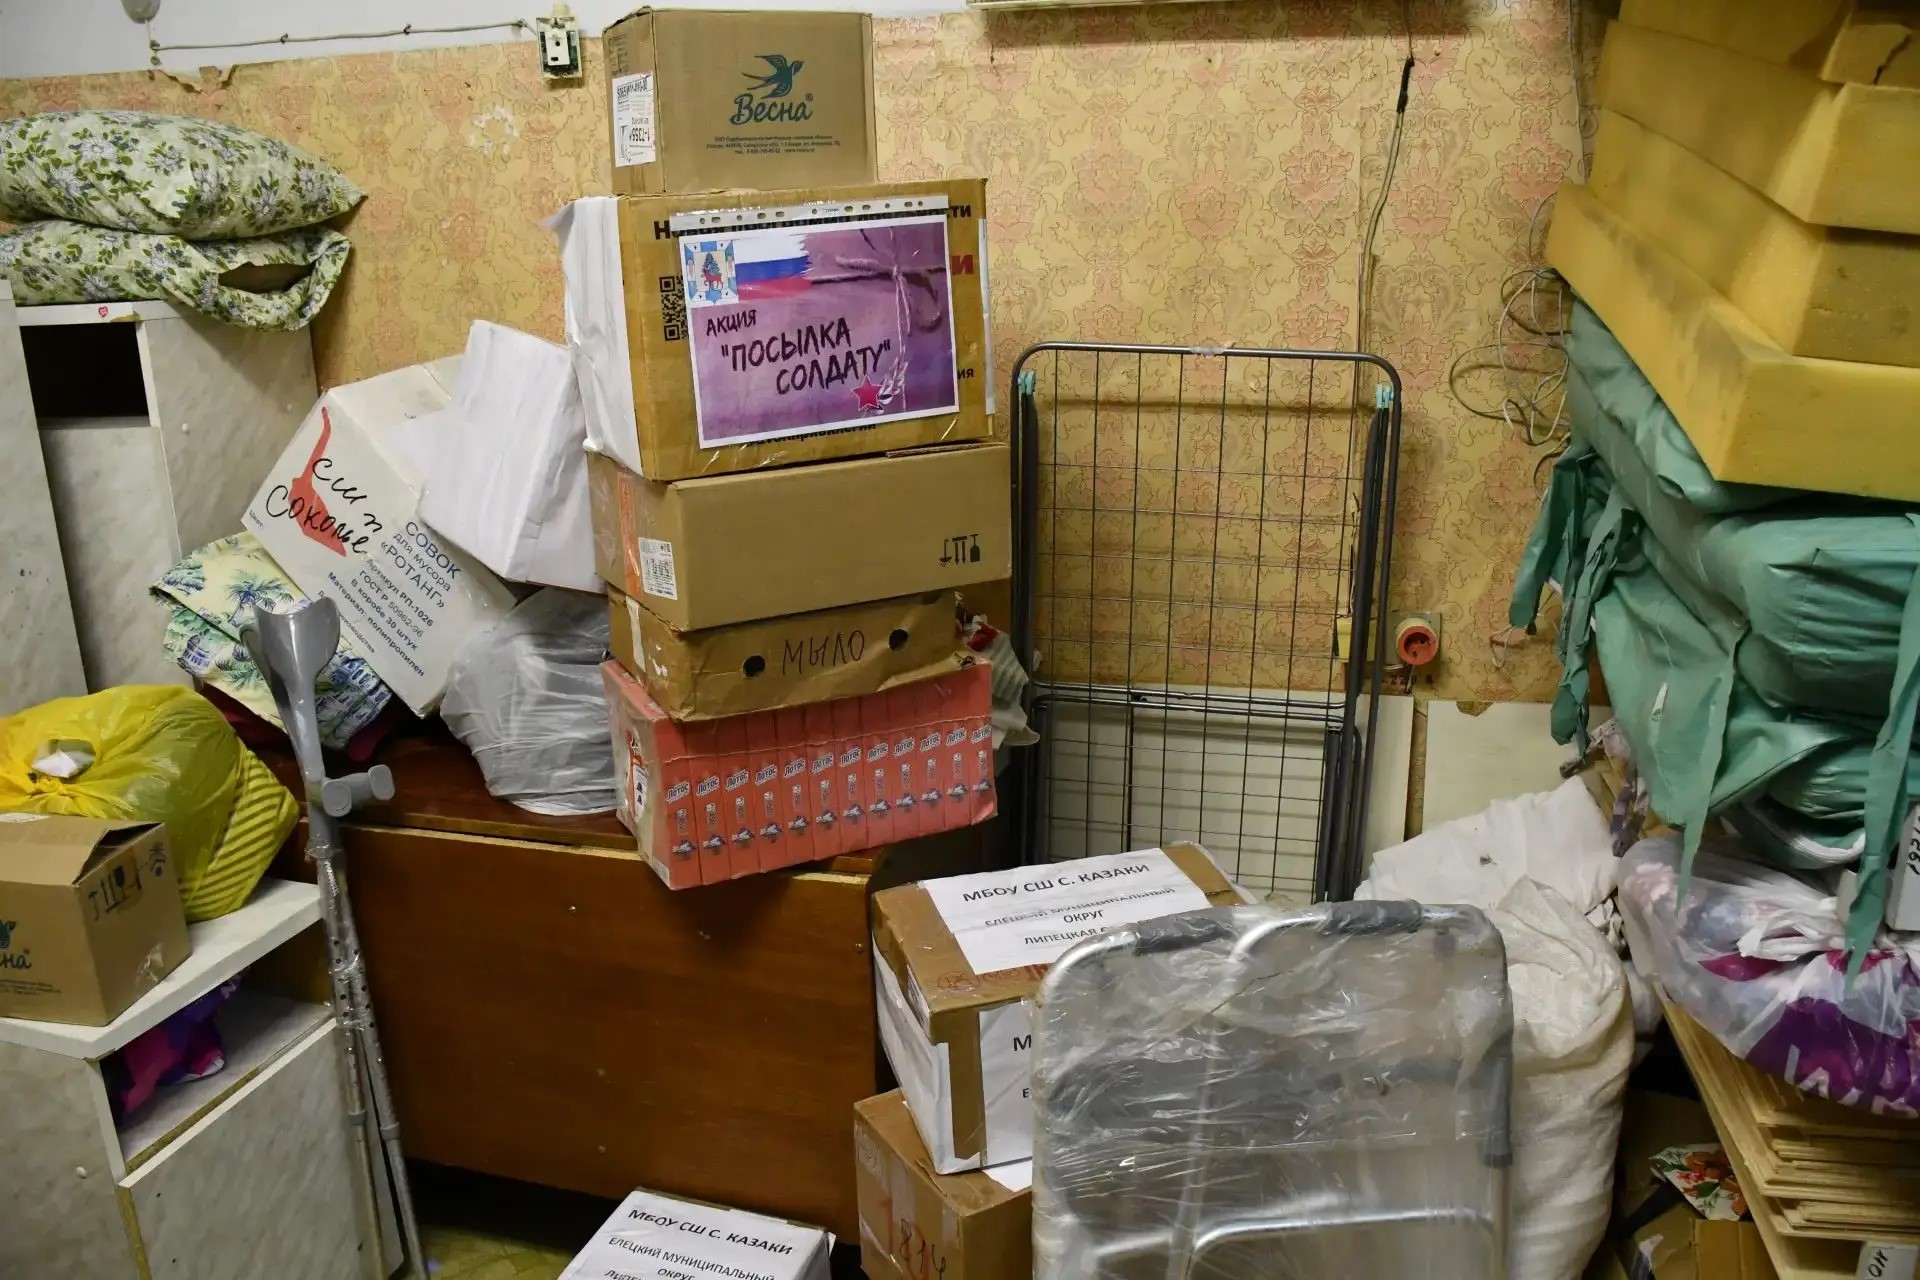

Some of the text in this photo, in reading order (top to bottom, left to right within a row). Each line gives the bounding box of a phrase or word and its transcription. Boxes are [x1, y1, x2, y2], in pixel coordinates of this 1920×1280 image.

[706, 309, 757, 337] АКЦИЯ
[721, 317, 852, 372] "ПОСЫЛКА
[776, 339, 891, 395] СОЛДАТУ"
[393, 532, 451, 592] для мусора
[405, 521, 462, 580] СОВОК
[359, 570, 382, 594] ГОСТ
[381, 593, 389, 601] Р
[381, 541, 445, 608] «РОТАНГ»
[328, 571, 425, 677] Материал: полипропилен
[351, 578, 418, 651] В коробе 30 штук
[399, 592, 434, 627] РП-1026
[782, 630, 865, 676] МЫЛО
[962, 864, 1150, 902] МБОУ СШ С. КАЗАКИ
[1024, 928, 1097, 945] ЛИПЕЦКАЯ
[1063, 909, 1104, 924] ОКРУГ
[608, 1237, 662, 1258] ЕЛЕЦКИЙ
[628, 1209, 793, 1255] МБОУ СШ С. КАЗАКИ
